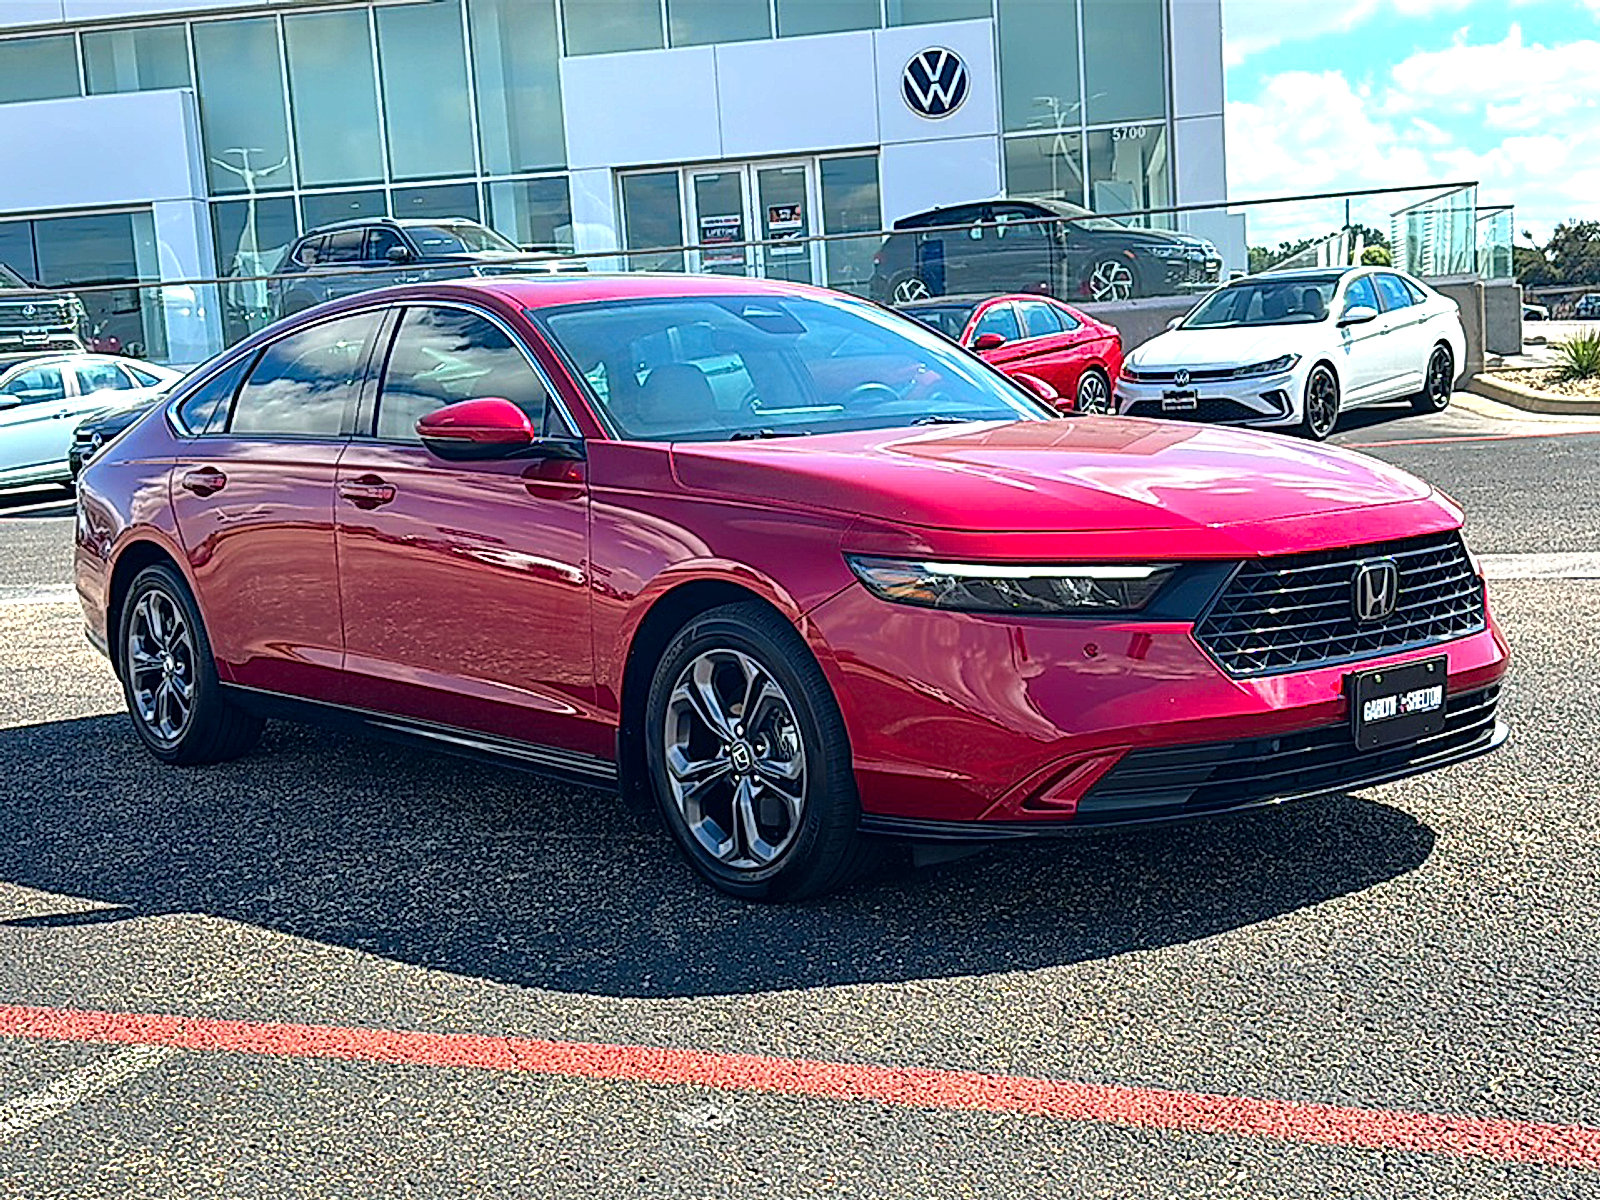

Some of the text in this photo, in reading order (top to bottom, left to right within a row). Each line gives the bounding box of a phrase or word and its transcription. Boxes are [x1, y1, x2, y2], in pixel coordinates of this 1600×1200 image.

[903, 49, 966, 114] VW
[1112, 127, 1146, 141] 5700
[1406, 685, 1443, 712] SHELTON
